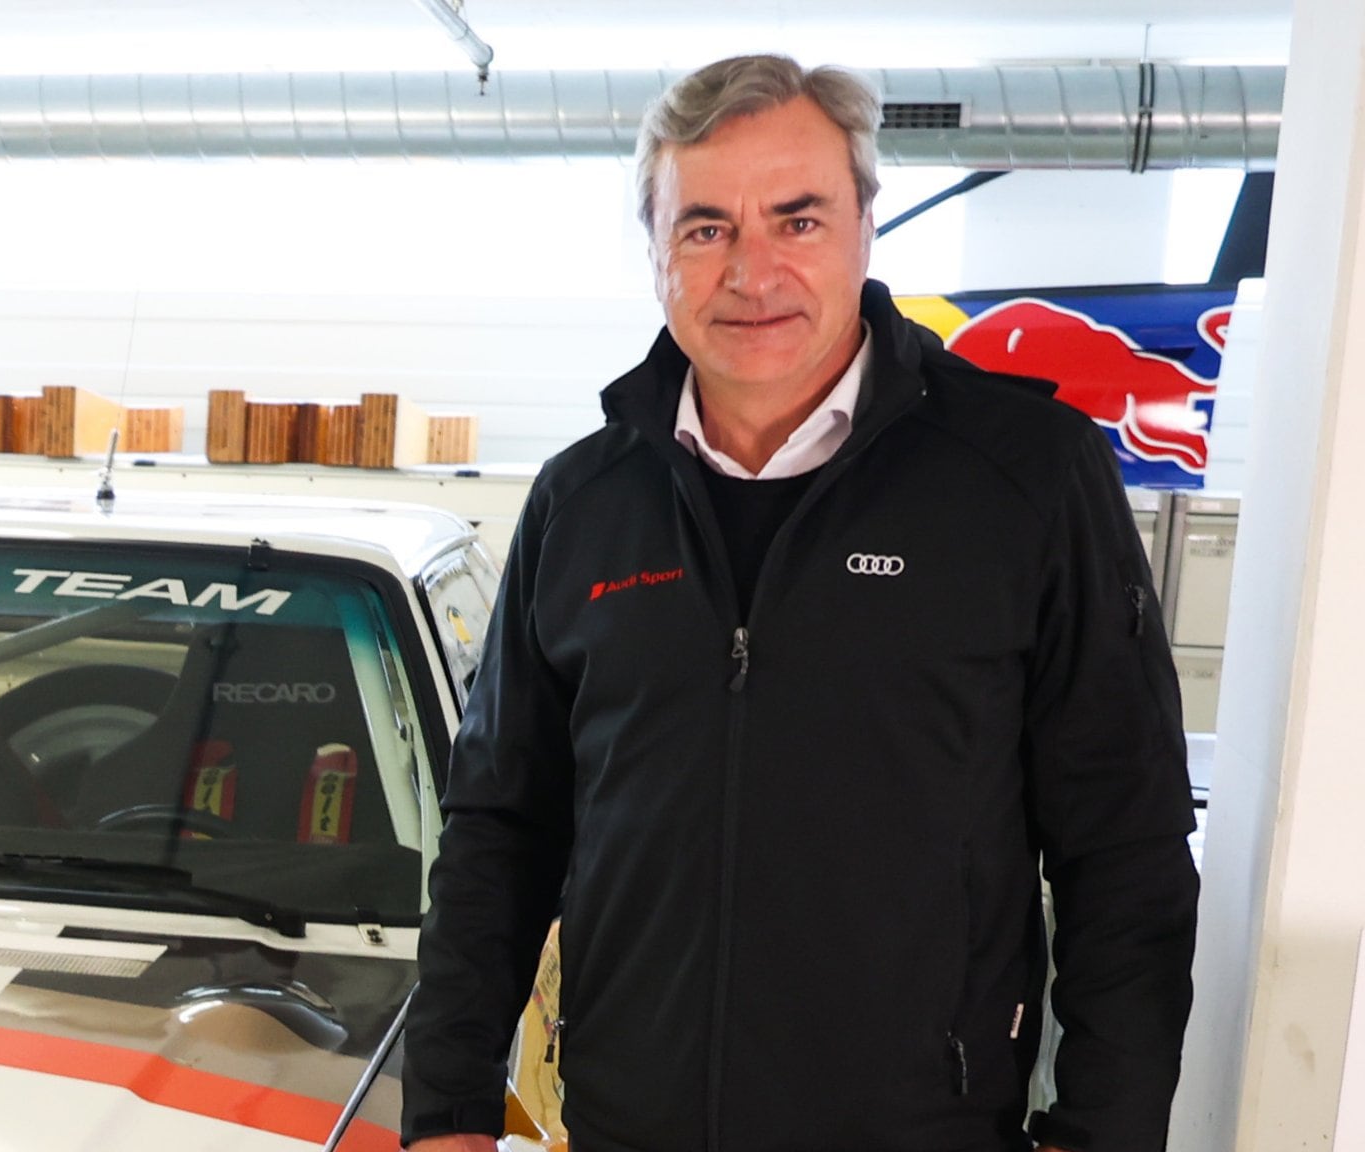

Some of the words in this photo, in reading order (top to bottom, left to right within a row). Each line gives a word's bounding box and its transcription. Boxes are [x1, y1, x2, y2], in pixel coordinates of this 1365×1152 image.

[12, 568, 292, 616] TEAM
[606, 575, 636, 592] Audi
[640, 568, 684, 586] Sport
[214, 682, 336, 703] RECARO
